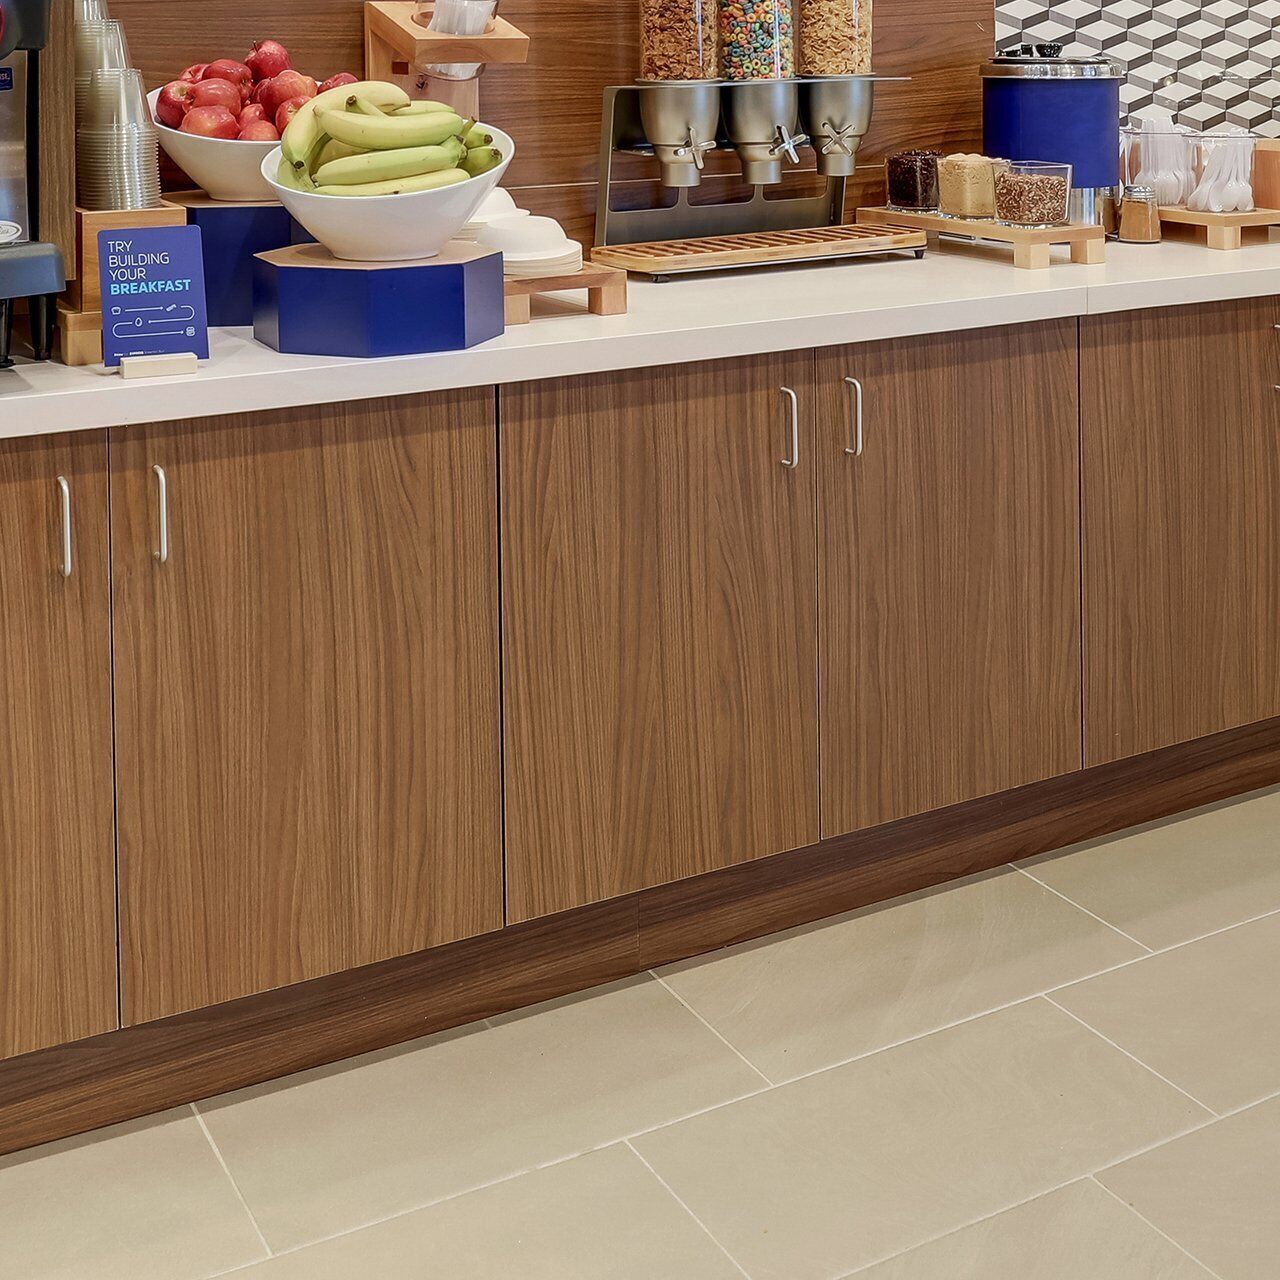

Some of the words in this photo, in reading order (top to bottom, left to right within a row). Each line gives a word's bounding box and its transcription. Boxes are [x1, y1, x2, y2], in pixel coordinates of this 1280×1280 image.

[107, 240, 133, 254] TRY
[108, 252, 170, 267] BUILDING
[109, 267, 147, 282] YOUR
[110, 278, 192, 296] BREAKFAST
